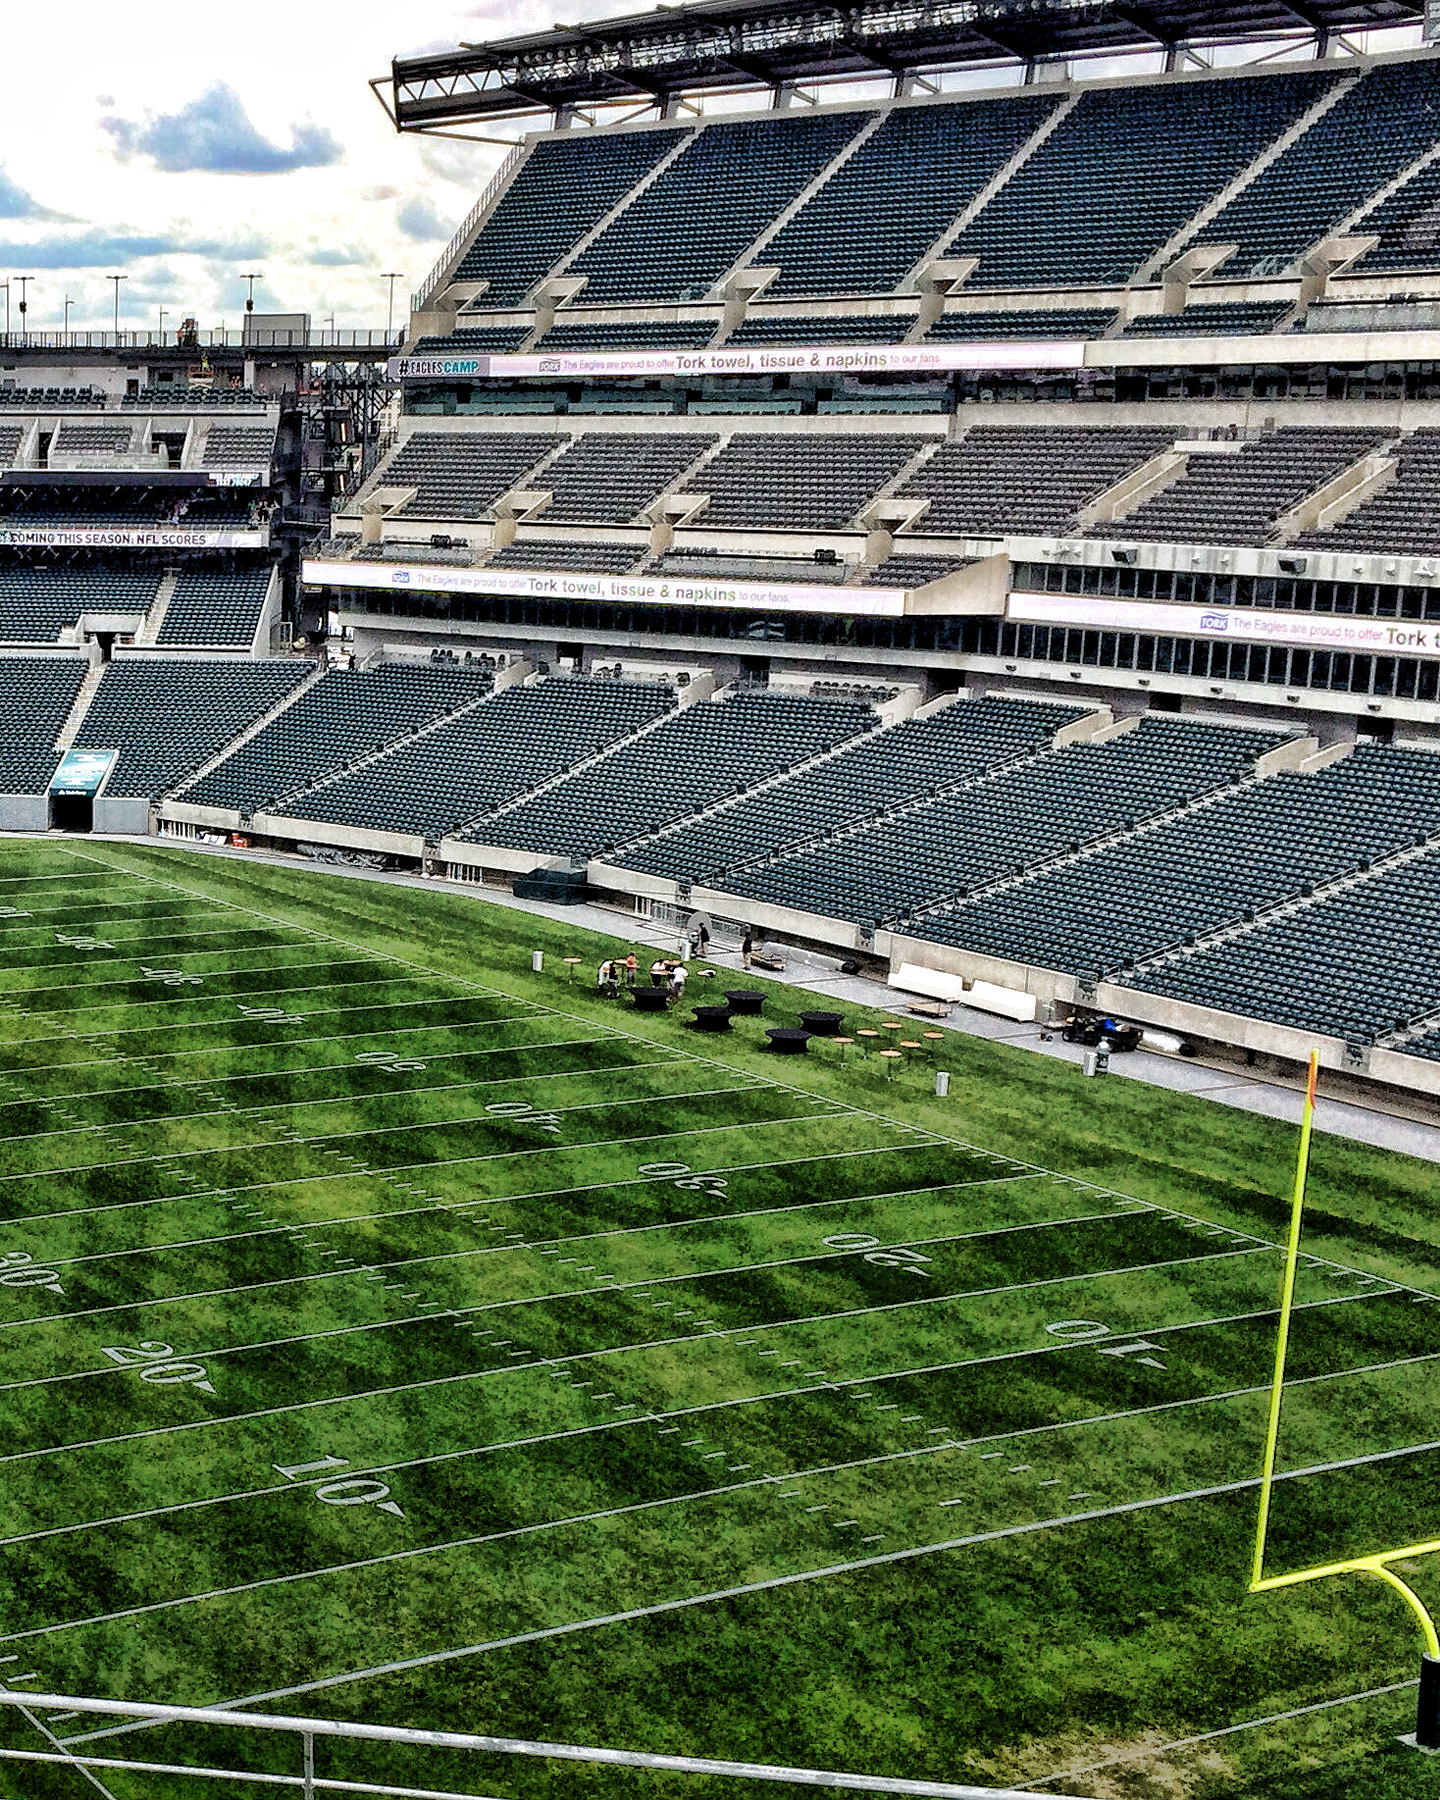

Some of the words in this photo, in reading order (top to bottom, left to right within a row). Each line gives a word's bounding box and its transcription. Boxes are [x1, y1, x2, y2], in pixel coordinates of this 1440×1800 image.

[399, 360, 479, 375] #EAGLESCAMP
[580, 360, 605, 370] Eagles
[621, 359, 644, 370] proud
[647, 359, 655, 367] to
[657, 359, 674, 367] offer
[676, 356, 706, 369] Tork
[711, 354, 755, 369] towel,
[760, 354, 805, 367] tissue
[810, 353, 820, 366] &
[826, 352, 887, 368] napkins
[890, 355, 900, 363] to
[11, 531, 54, 544] COMING
[58, 532, 82, 544] THIS
[85, 532, 134, 545] SEASON:
[137, 533, 159, 545] NFL
[162, 533, 206, 545] SCORES
[474, 578, 497, 588] proud
[499, 579, 507, 587] to
[528, 577, 558, 592] Tork
[563, 580, 606, 597] towel,
[611, 582, 655, 597] tissue
[660, 584, 670, 598] &
[675, 586, 736, 602] napkins
[739, 591, 749, 600] to
[751, 592, 765, 600] our
[1233, 618, 1251, 630] The
[1254, 619, 1288, 634] Eagles
[1290, 624, 1307, 634] are
[1310, 626, 1342, 637] proud
[1345, 628, 1355, 638] to
[1358, 628, 1384, 640] offer
[1387, 627, 1427, 647] Tork
[636, 1161, 730, 1191] 30
[821, 1232, 933, 1267] 20
[1044, 1319, 1169, 1359] 10
[100, 1340, 208, 1385] 20
[271, 1454, 391, 1506] 10
